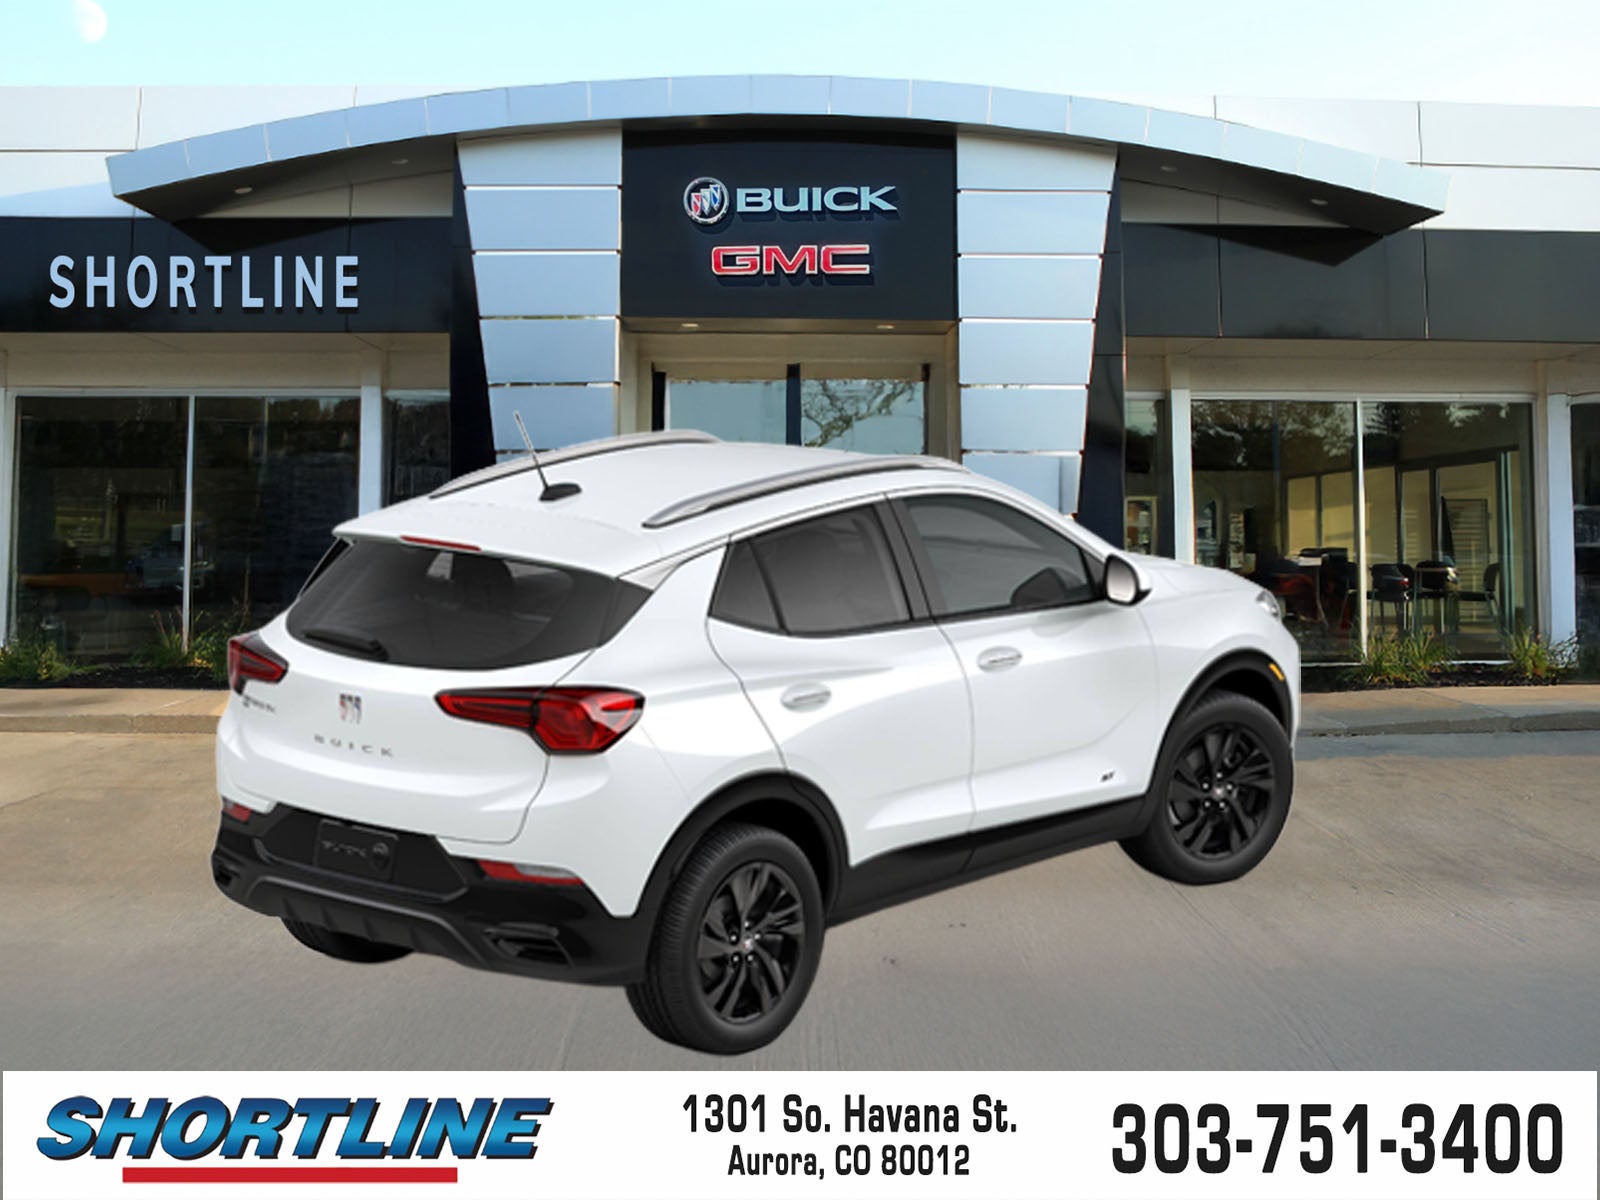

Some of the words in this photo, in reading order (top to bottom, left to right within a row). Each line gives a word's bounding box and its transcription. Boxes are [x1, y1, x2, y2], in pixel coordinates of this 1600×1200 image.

[736, 185, 898, 213] BUICK
[711, 244, 870, 276] GMC
[49, 255, 359, 309] SHORTLINE
[313, 733, 394, 758] BUICK
